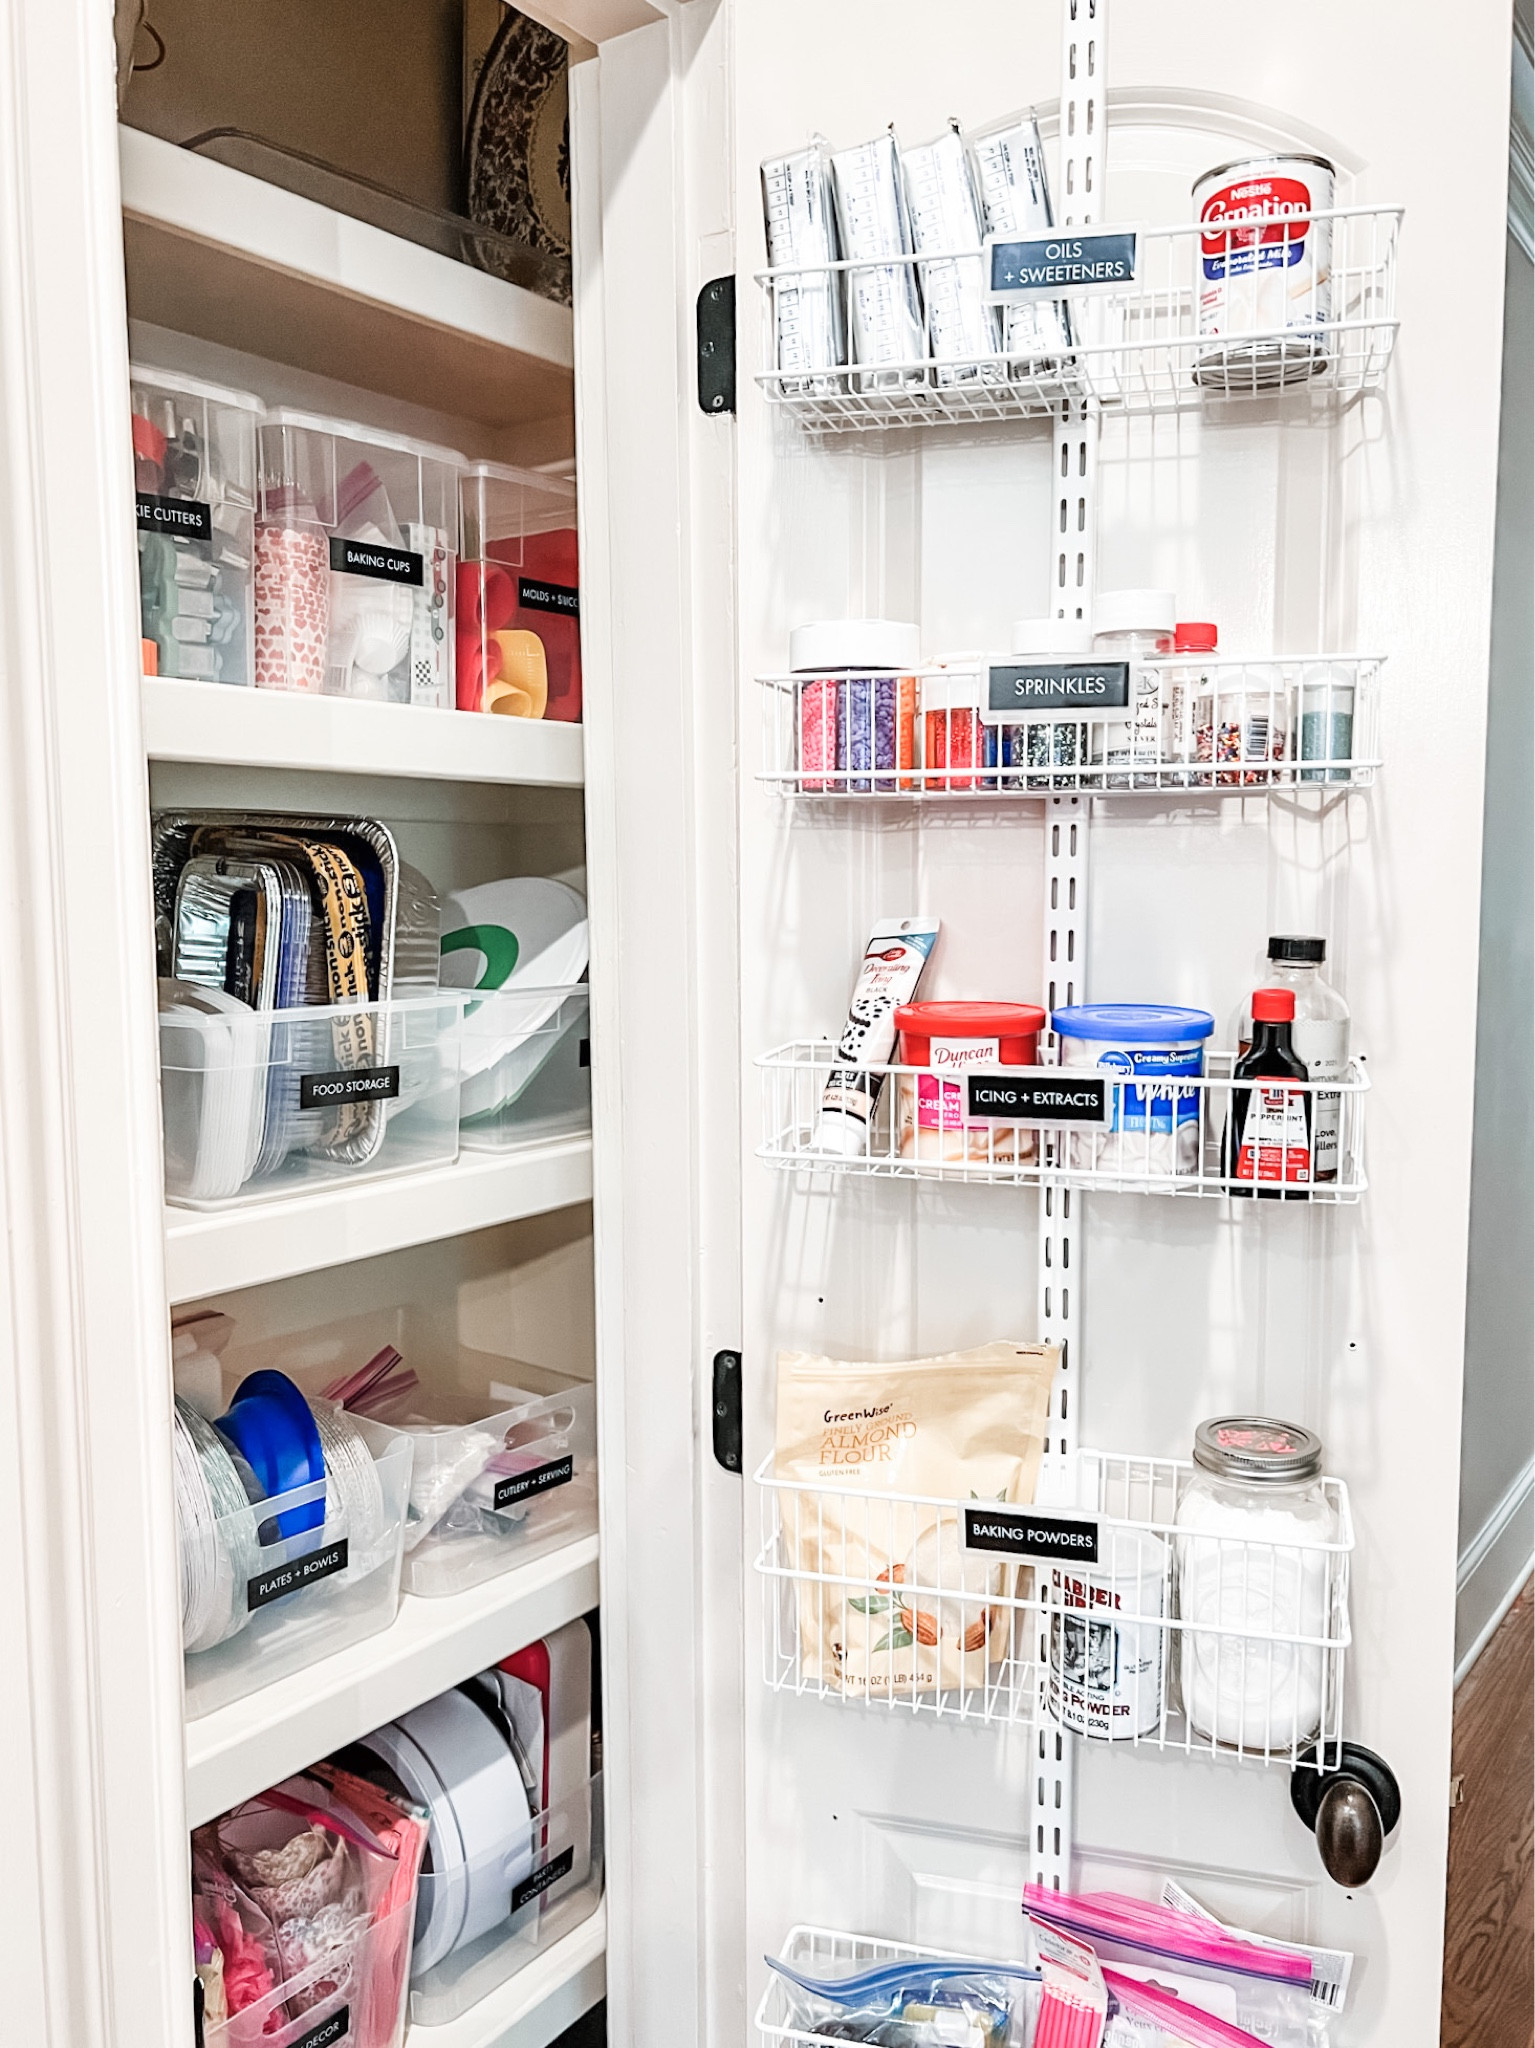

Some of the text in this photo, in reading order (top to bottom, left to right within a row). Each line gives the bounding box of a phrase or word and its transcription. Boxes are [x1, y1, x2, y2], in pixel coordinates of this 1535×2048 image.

[1202, 196, 1308, 240] Carnation
[1046, 242, 1083, 260] OILS
[1004, 261, 1125, 284] + SWEETENERS
[154, 507, 203, 527] CUTTERS
[347, 550, 411, 573] BAKING CUPS
[522, 588, 550, 603] MOLDS
[1014, 676, 1106, 696] SPRINKLES
[1125, 717, 1157, 735] Cystals
[934, 1046, 993, 1064] Duncan
[1133, 1052, 1170, 1065] Creamy
[312, 1076, 390, 1096] FOOD STORAGE
[975, 1089, 1099, 1107] ICING + EXTRACTS
[1251, 1113, 1303, 1123] PPPERINT
[824, 1403, 892, 1423] GreenWise
[823, 1412, 913, 1437] FINELY GROUND
[819, 1421, 917, 1449] ALMOND
[819, 1444, 892, 1464] FLOUR
[498, 1480, 529, 1500] CUTLERY
[538, 1464, 570, 1485] SERVING
[973, 1523, 1093, 1548] BAKING POWDERS
[260, 1572, 293, 1596] PLATES
[303, 1552, 339, 1576] BOWLS
